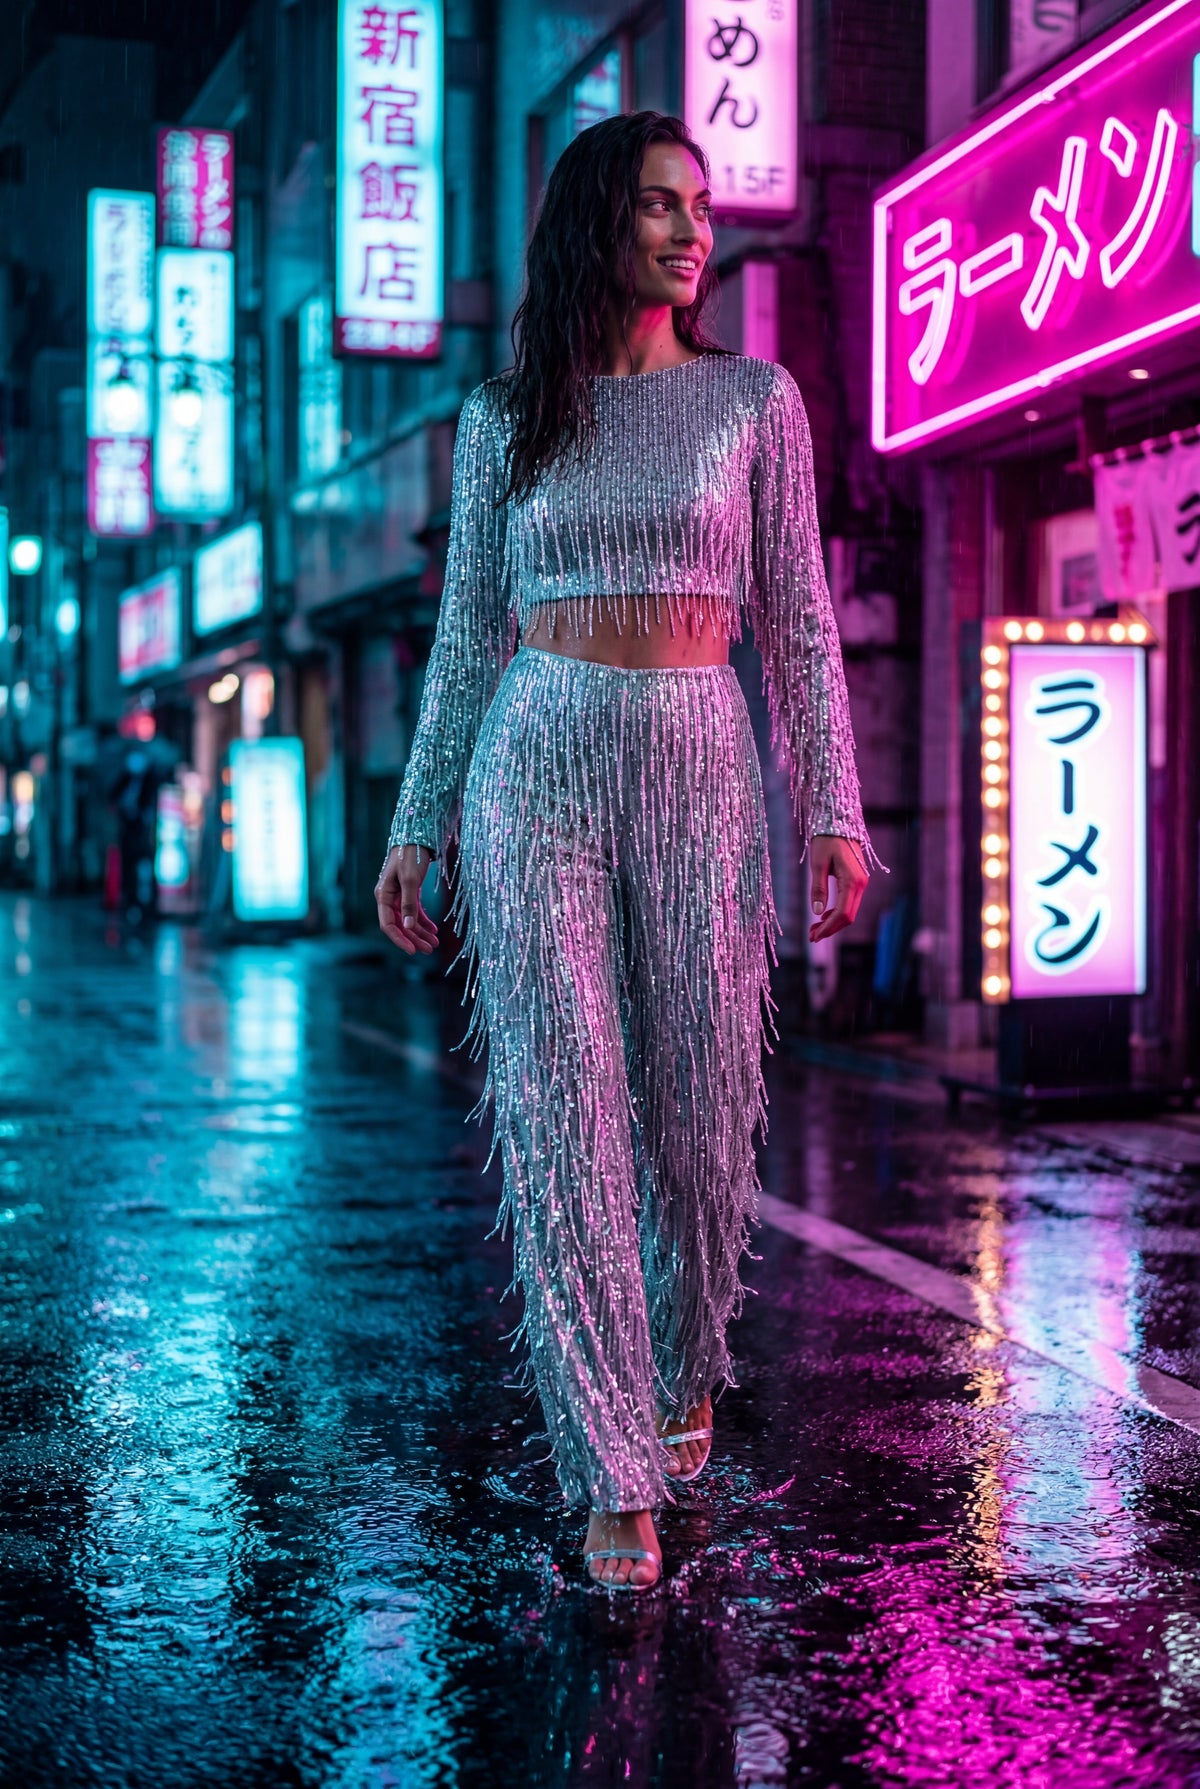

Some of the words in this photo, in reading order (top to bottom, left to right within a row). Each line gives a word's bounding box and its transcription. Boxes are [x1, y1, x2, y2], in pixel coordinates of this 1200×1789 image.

[360, 5, 419, 301] 新宿飯店
[707, 0, 760, 129] めん
[724, 164, 785, 195] 15F
[899, 108, 1178, 385] ラーメン
[1035, 680, 1102, 966] ラーメン
